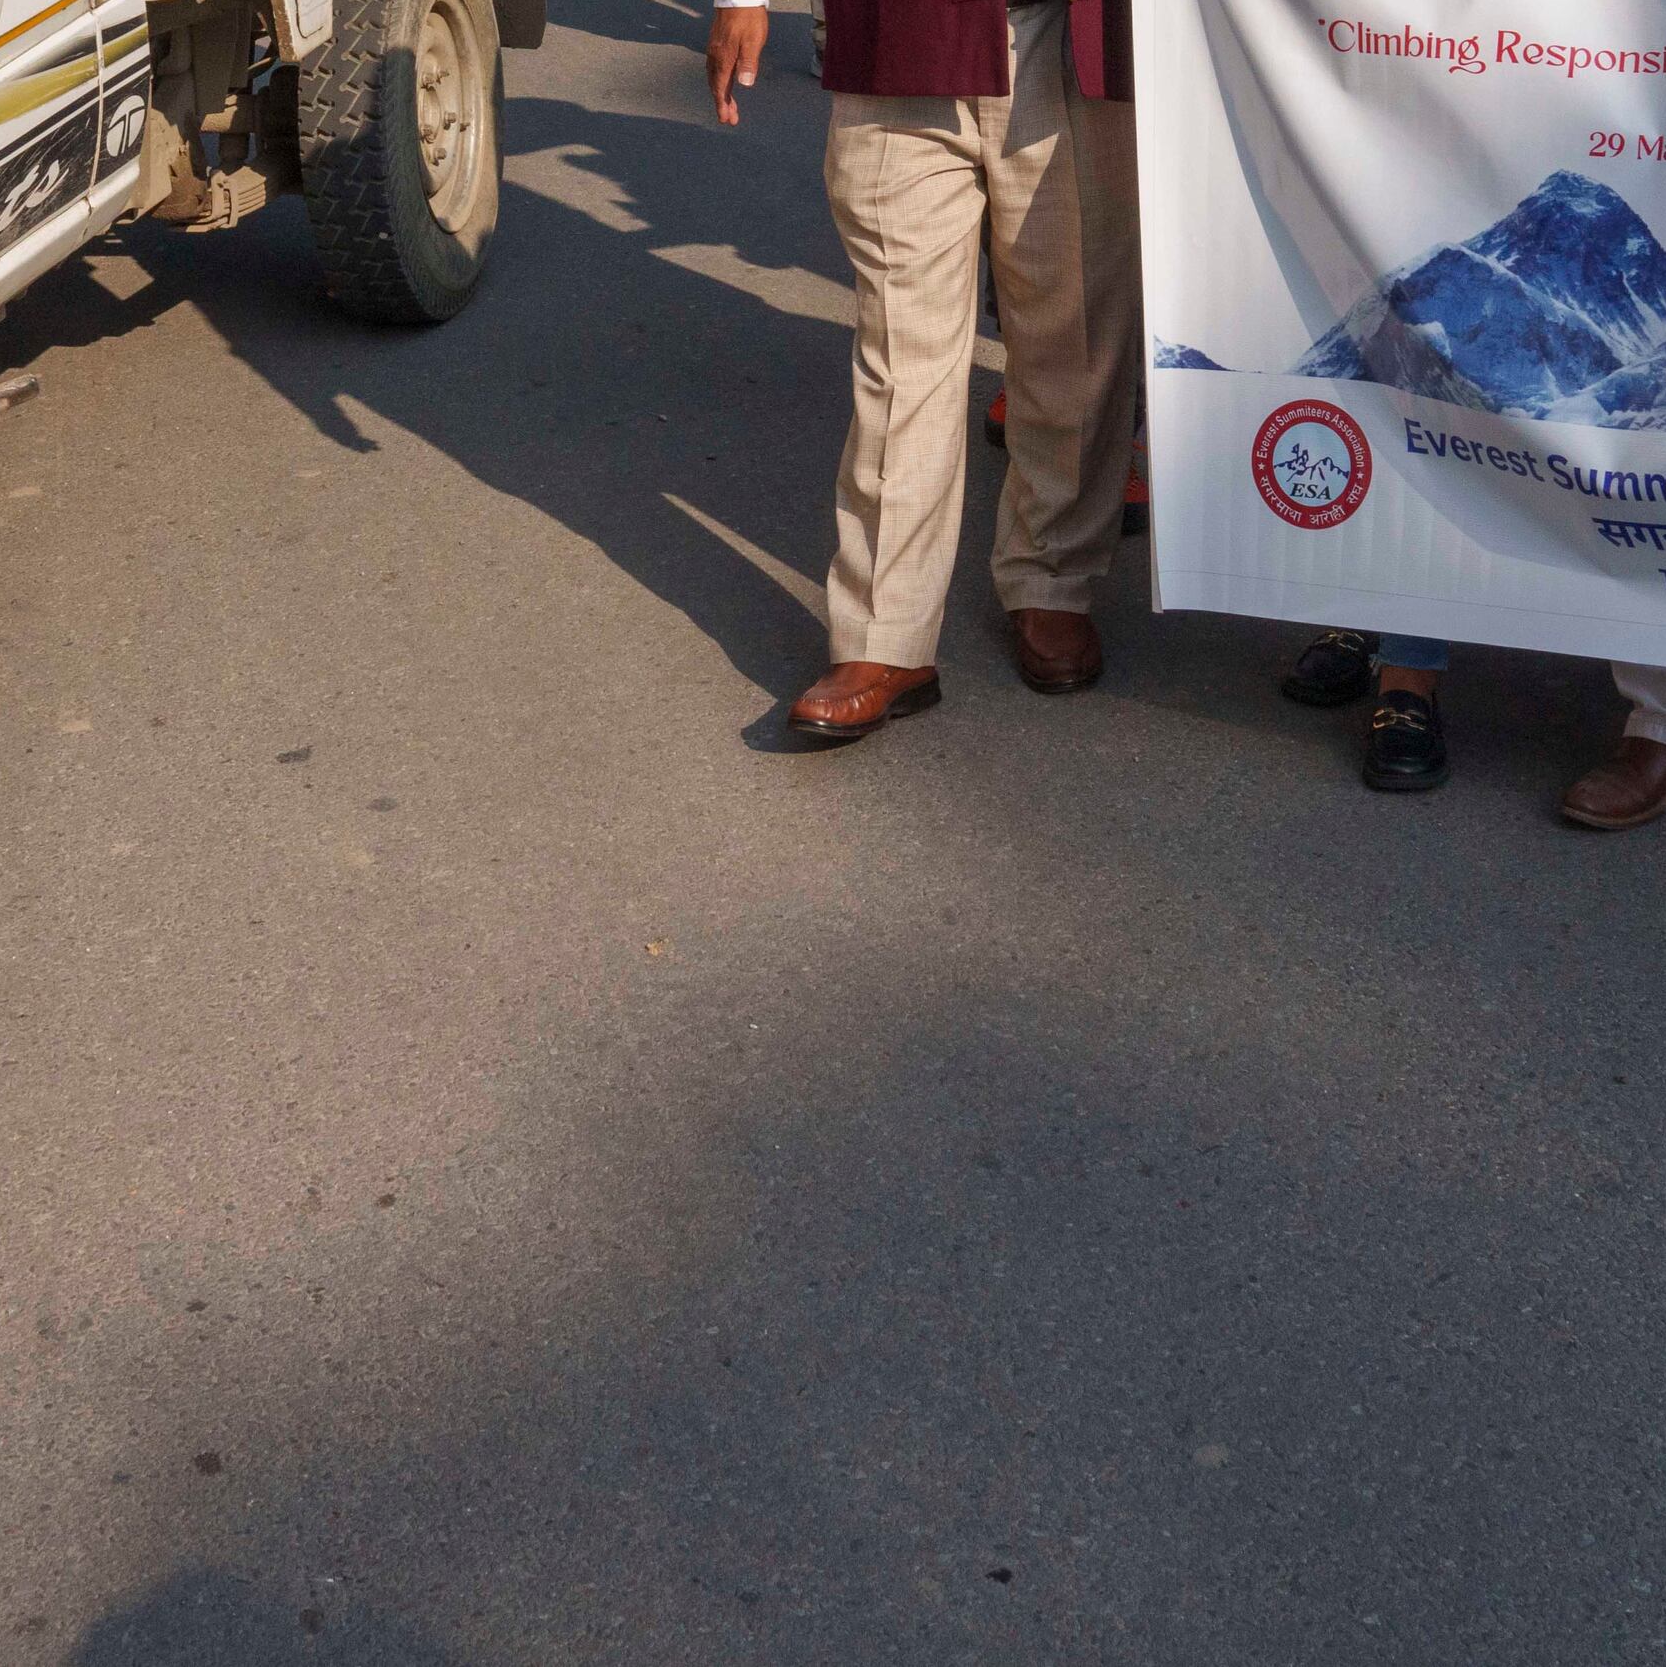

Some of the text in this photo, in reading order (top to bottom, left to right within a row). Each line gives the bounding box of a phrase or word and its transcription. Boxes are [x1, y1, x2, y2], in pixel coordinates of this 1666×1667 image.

[1589, 132, 1625, 158] 29
[1256, 405, 1366, 468] Everest Summiteers Association
[1403, 417, 1544, 483] Everest
[1290, 482, 1332, 500] ESA
